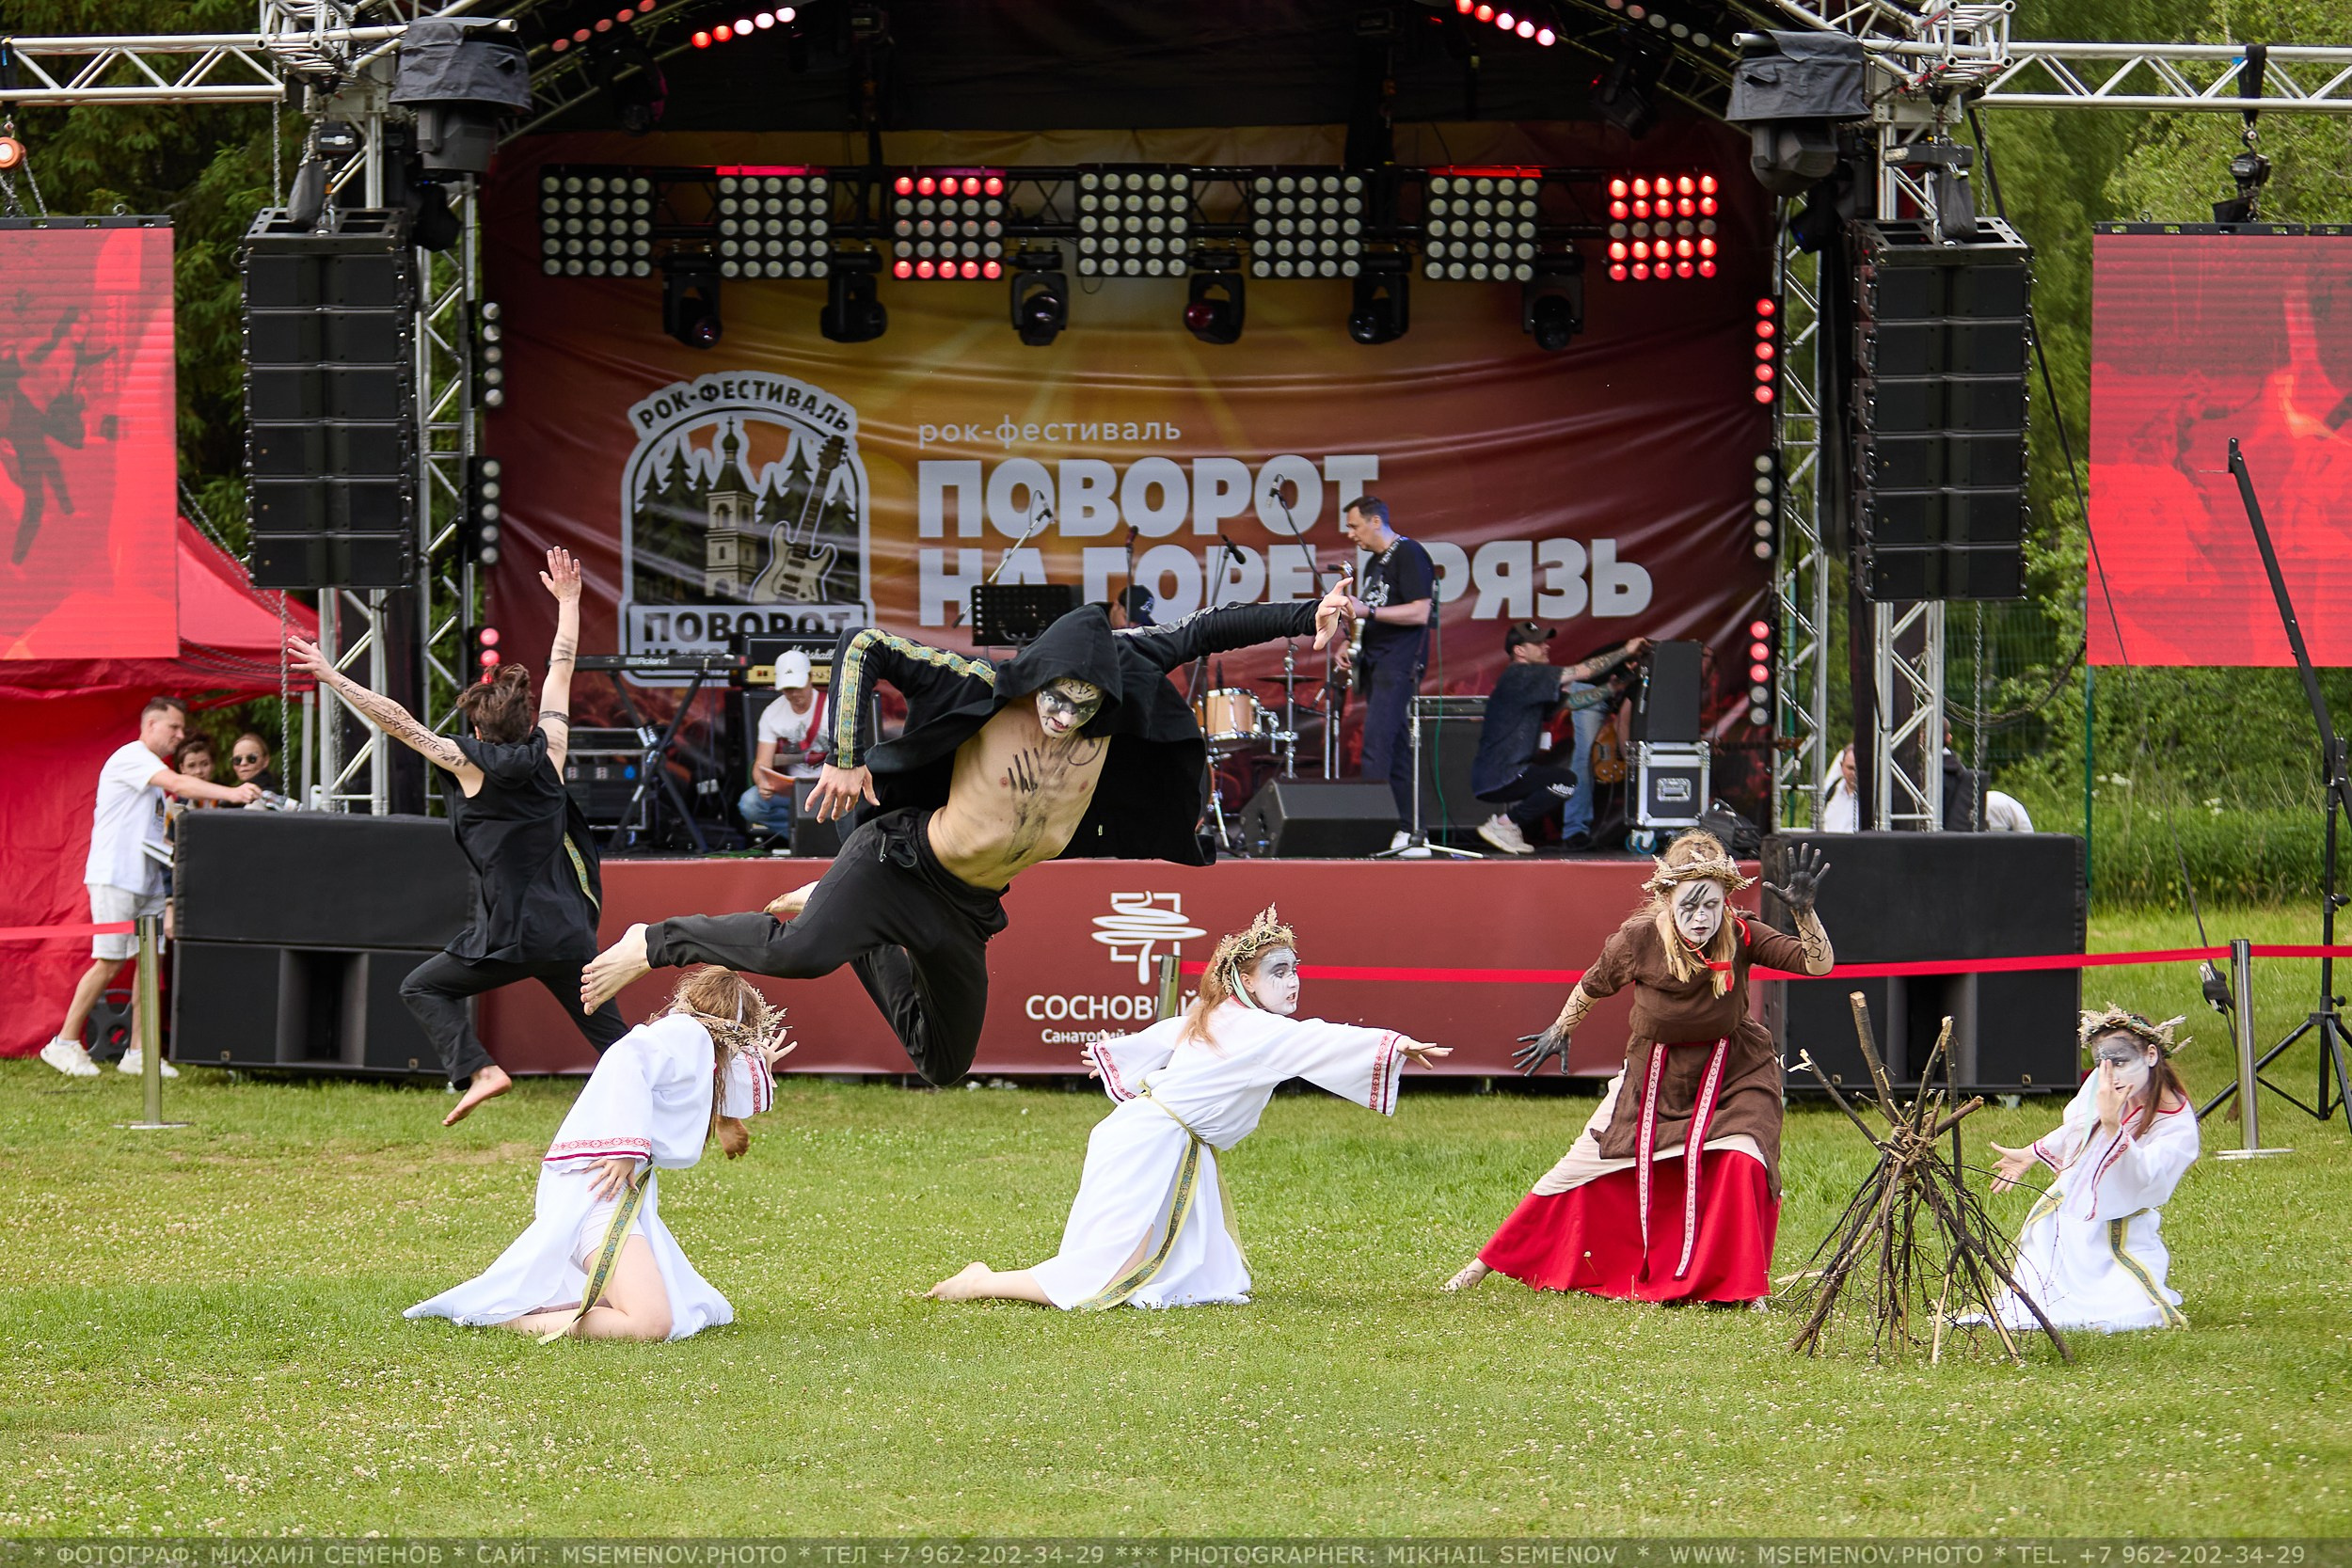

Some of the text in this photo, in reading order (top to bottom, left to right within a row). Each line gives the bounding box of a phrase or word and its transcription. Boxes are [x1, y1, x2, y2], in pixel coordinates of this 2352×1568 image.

[638, 379, 850, 432] РОК-ФЕСТИВАЛЬ
[919, 414, 1182, 450] рок-фестиваль
[918, 454, 1380, 539] ПОВОРОТ
[644, 611, 851, 642] ПОВОРОТ
[639, 657, 669, 665] Roland
[792, 644, 836, 660] rshall
